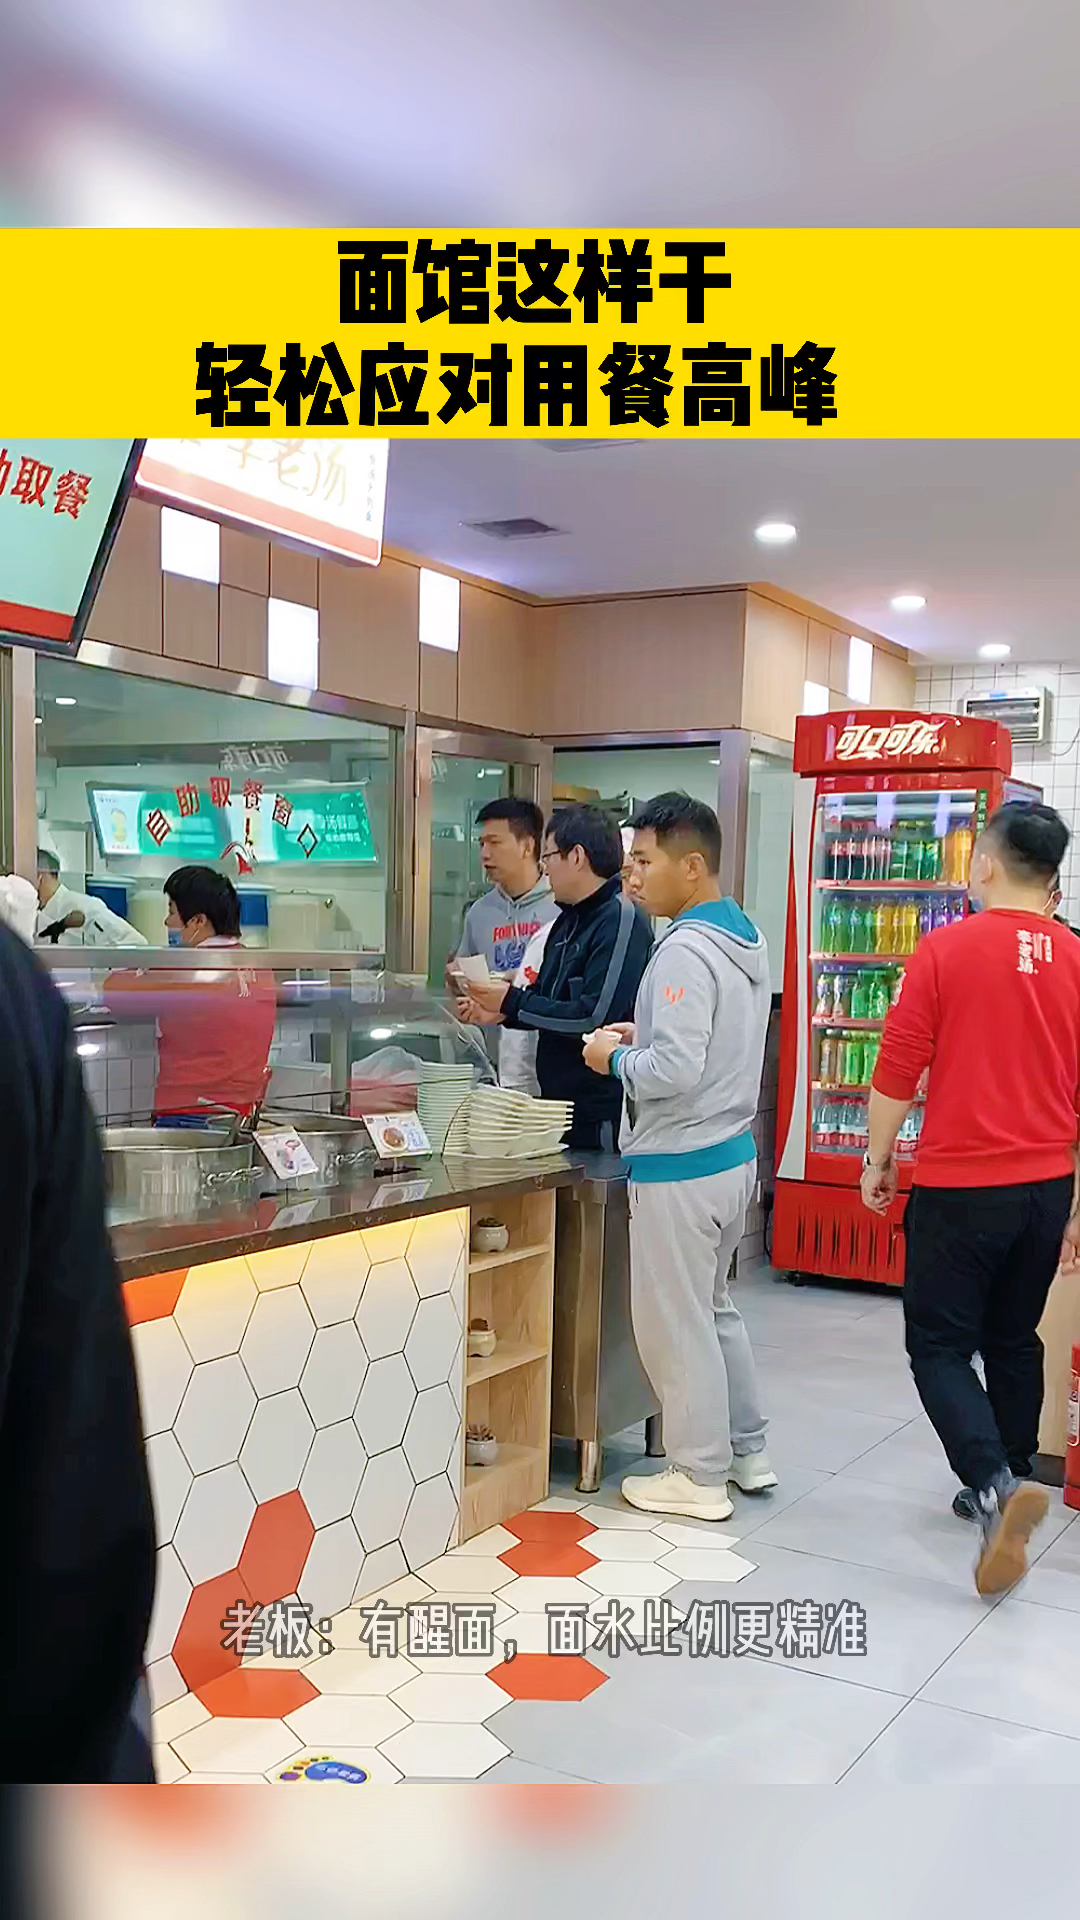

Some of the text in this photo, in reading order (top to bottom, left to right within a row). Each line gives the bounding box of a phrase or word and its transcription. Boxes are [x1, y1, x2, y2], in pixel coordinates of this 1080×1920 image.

[836, 720, 947, 760] 可口可乐
[146, 776, 318, 858] 自助取餐窗口
